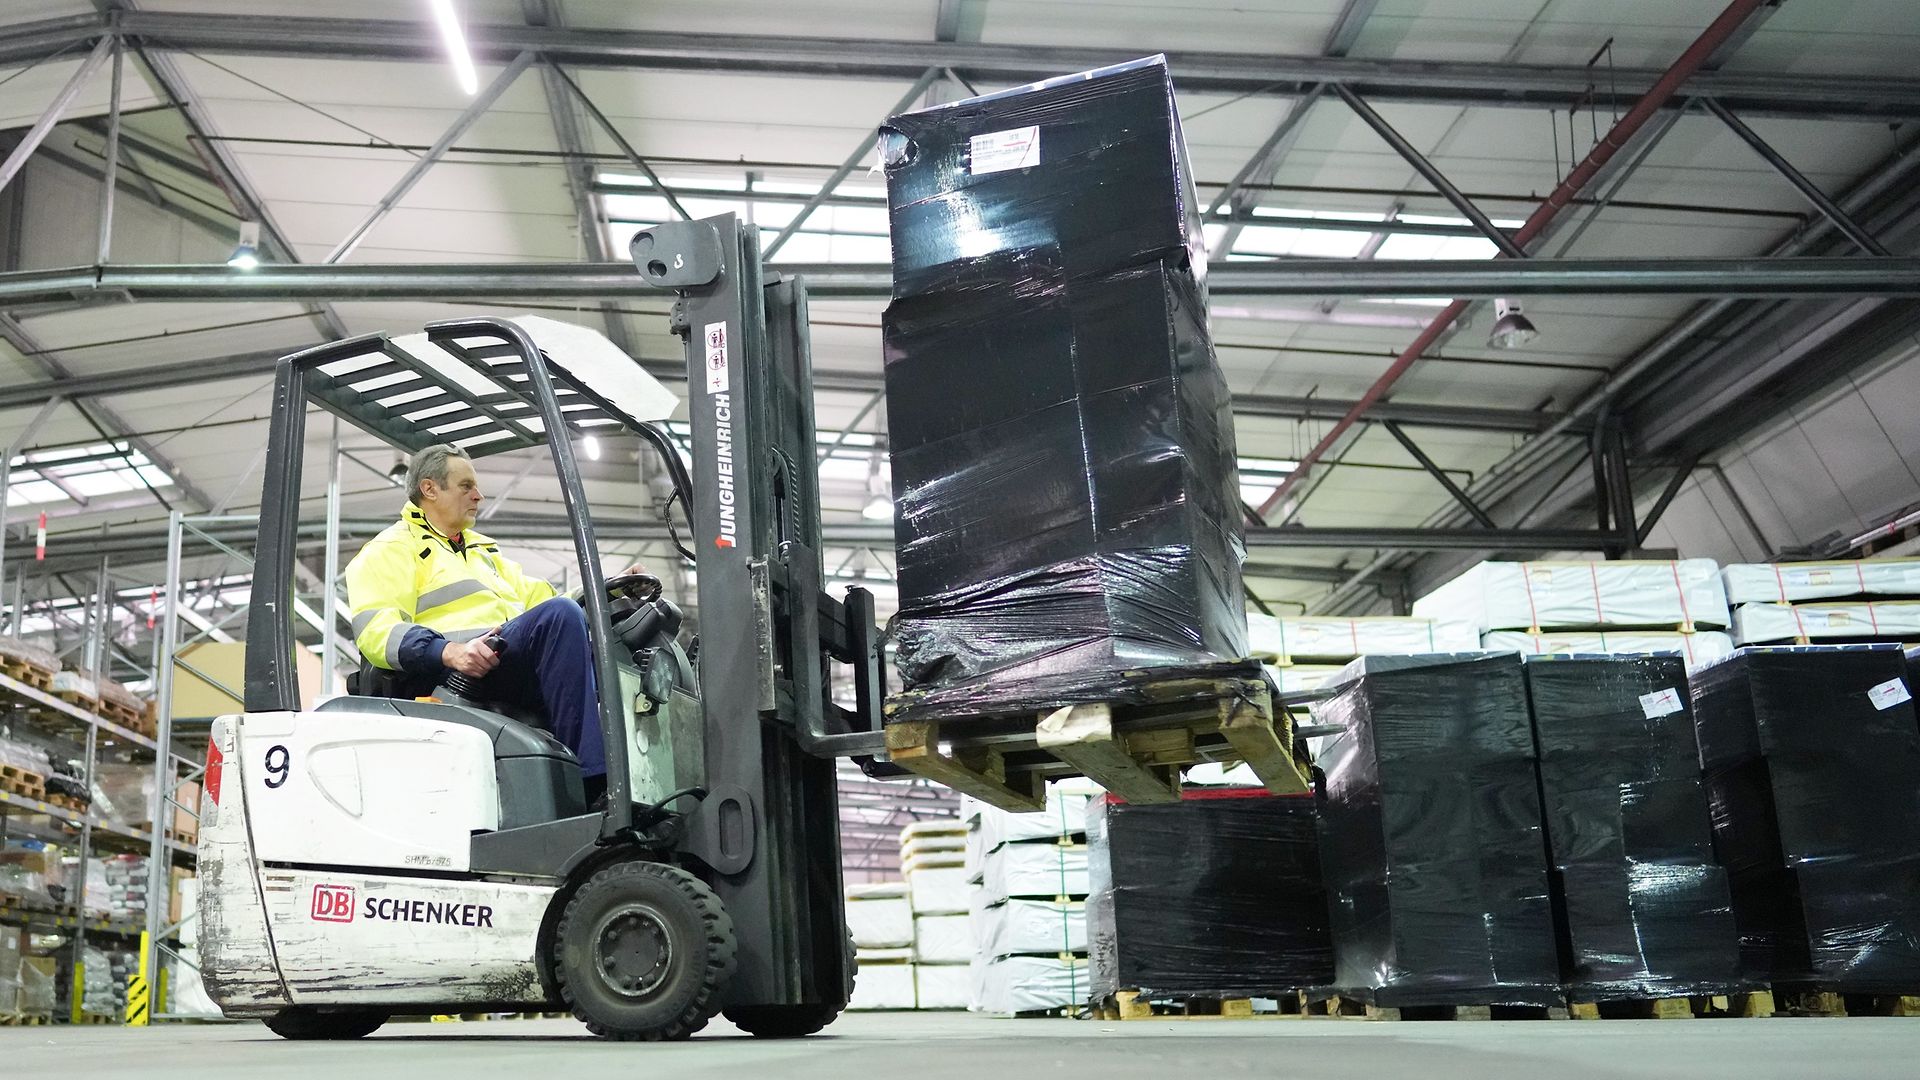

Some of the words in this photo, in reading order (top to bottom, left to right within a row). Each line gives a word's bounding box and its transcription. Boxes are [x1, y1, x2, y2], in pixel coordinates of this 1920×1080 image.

[715, 394, 736, 549] JUNGHEINRICH
[264, 744, 290, 789] 9
[316, 889, 350, 917] DB
[364, 897, 494, 929] SCHENKER
